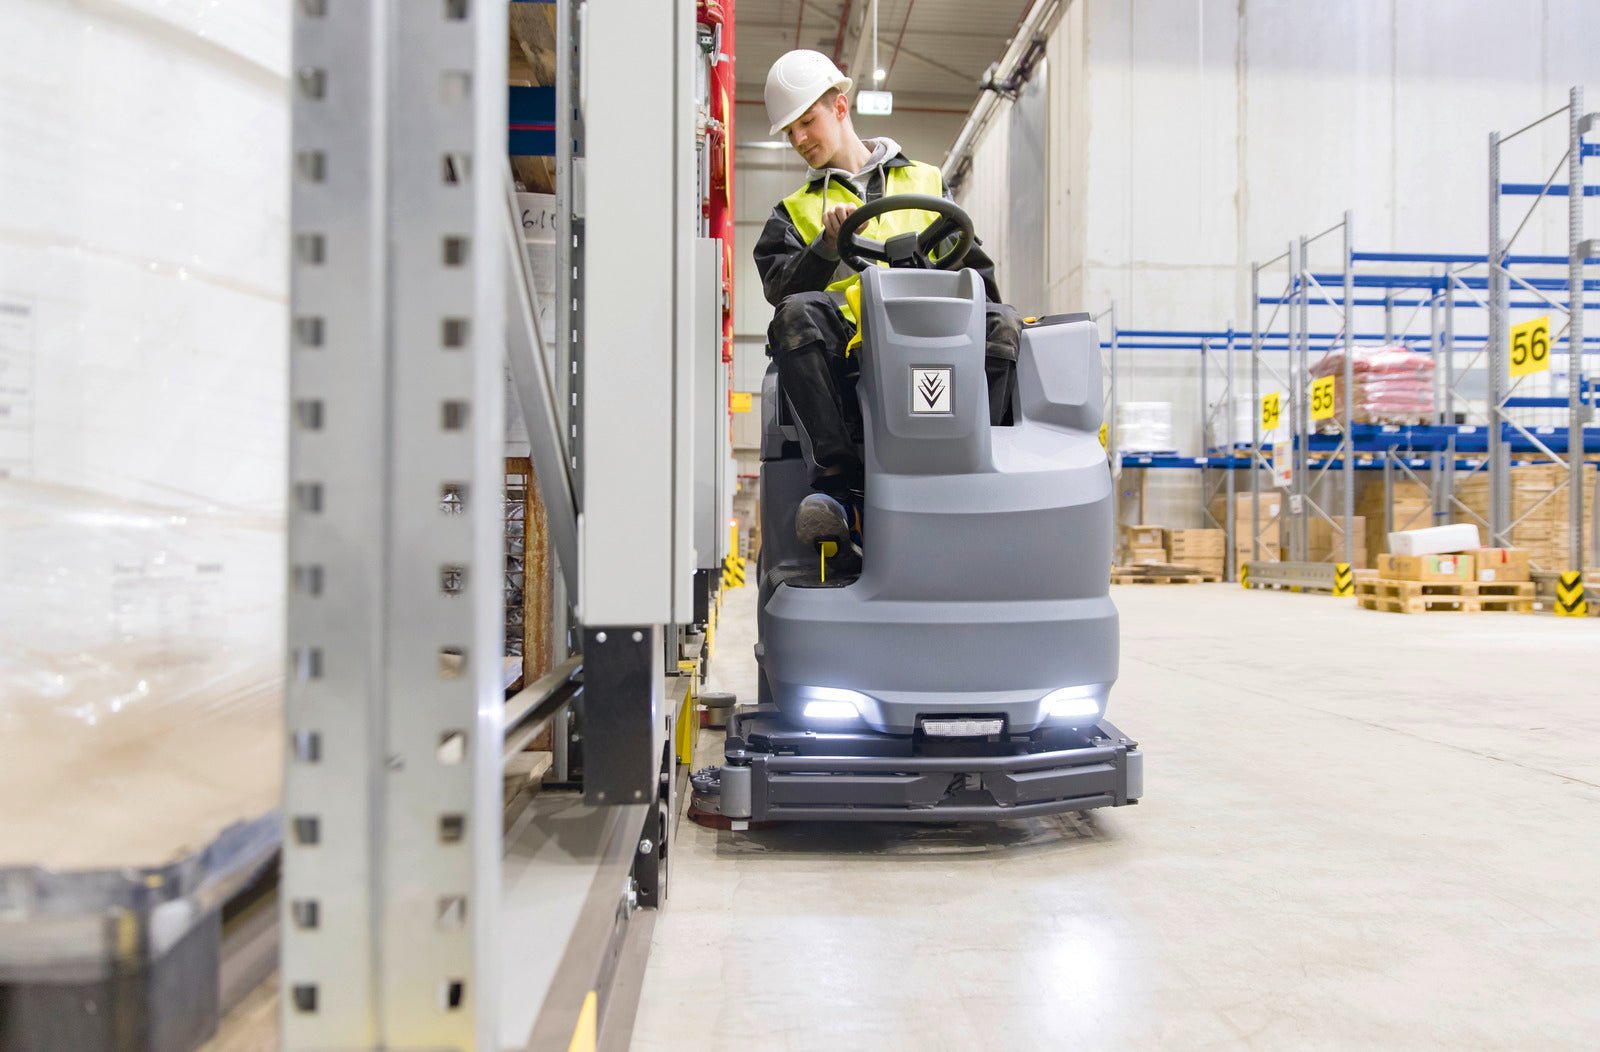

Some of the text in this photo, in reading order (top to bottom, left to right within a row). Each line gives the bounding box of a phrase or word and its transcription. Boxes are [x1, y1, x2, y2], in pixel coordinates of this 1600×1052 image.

[1512, 326, 1548, 366] 56
[1263, 397, 1280, 424] 54
[1313, 384, 1333, 412] 55
